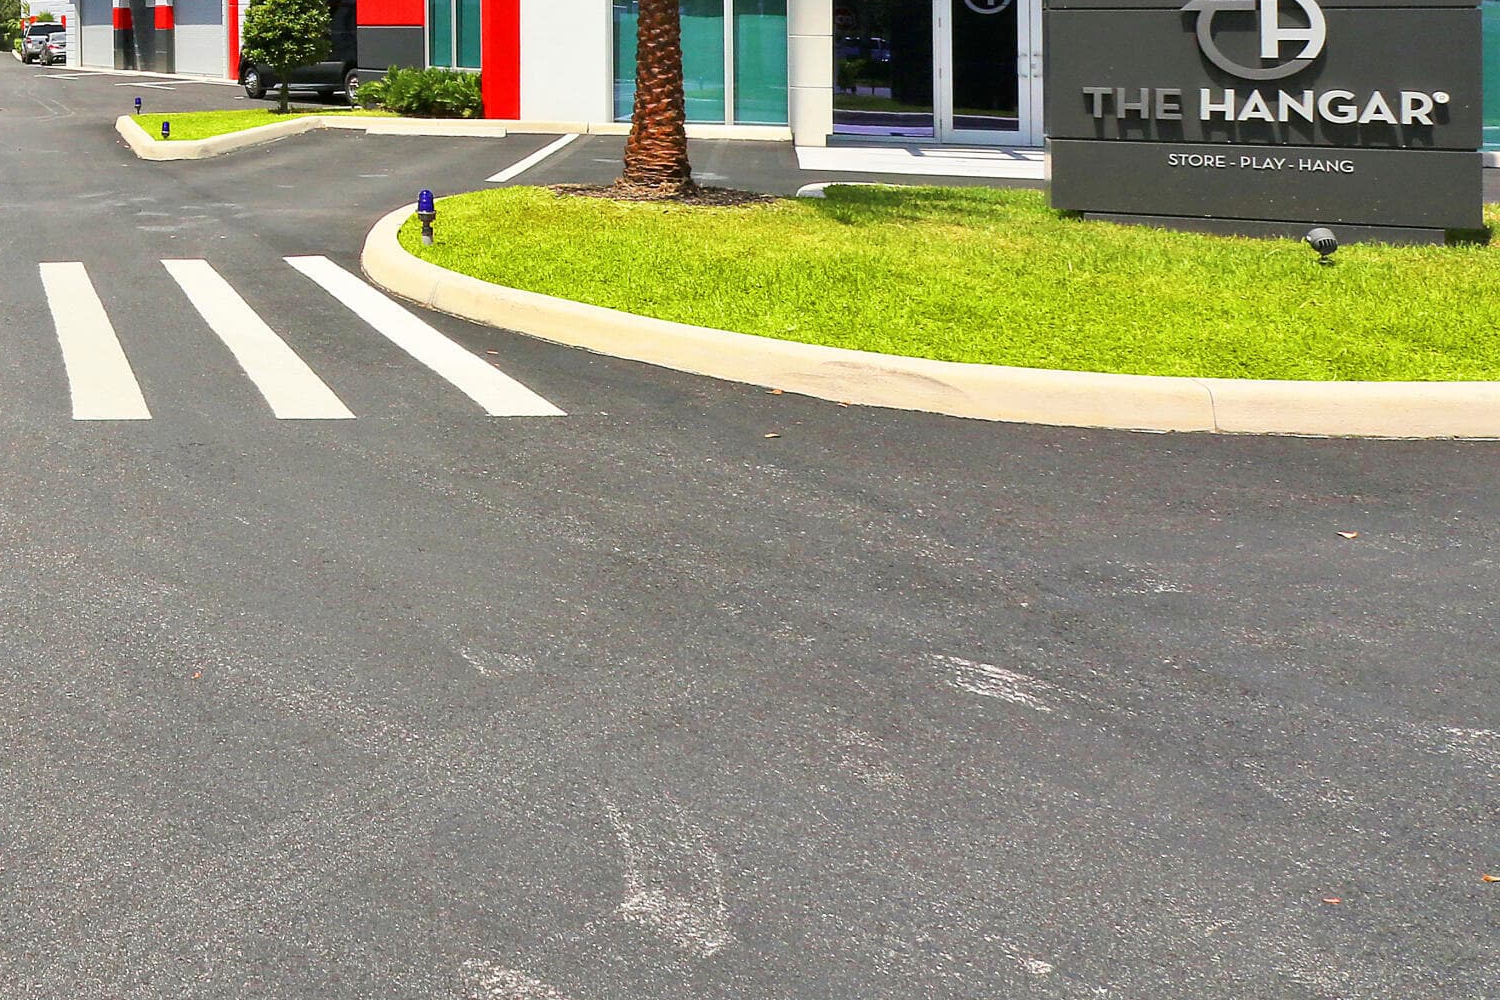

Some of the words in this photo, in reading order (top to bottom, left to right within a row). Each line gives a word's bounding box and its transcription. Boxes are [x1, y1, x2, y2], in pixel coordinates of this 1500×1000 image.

[1082, 86, 1183, 120] THE
[1167, 153, 1227, 168] STORE
[1240, 156, 1286, 170] PLAY
[1299, 158, 1355, 173] HANG
